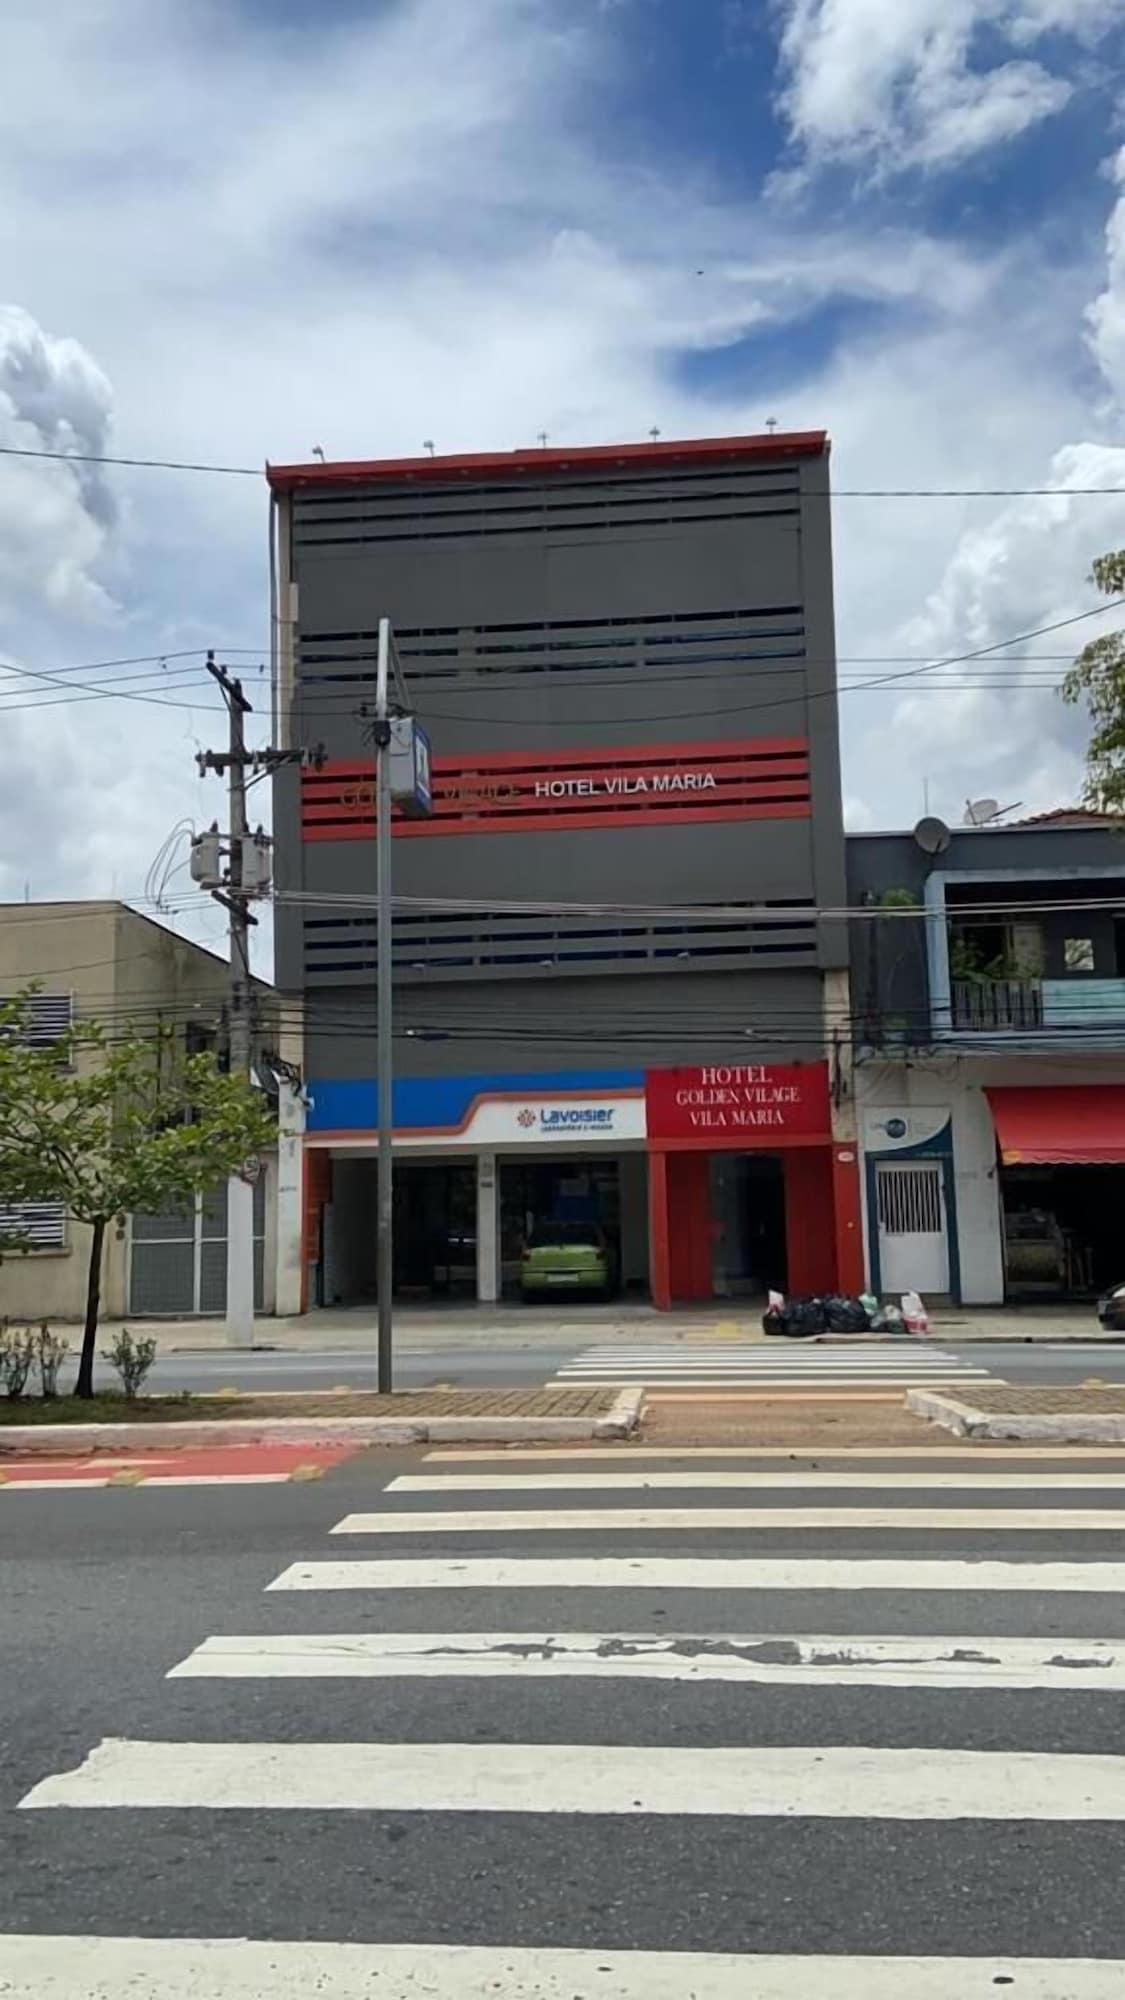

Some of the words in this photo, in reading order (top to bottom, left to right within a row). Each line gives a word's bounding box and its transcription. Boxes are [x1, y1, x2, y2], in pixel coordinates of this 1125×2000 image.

[534, 778, 601, 798] HOTEL
[604, 776, 649, 794] VILA
[653, 772, 717, 792] MARIA
[701, 1065, 773, 1085] HOTEL
[675, 1087, 740, 1105] GOLDEN
[744, 1085, 801, 1103] VILAGE
[540, 1108, 616, 1124] Lavoisier
[690, 1109, 728, 1126] VILA
[731, 1108, 785, 1126] MARIA
